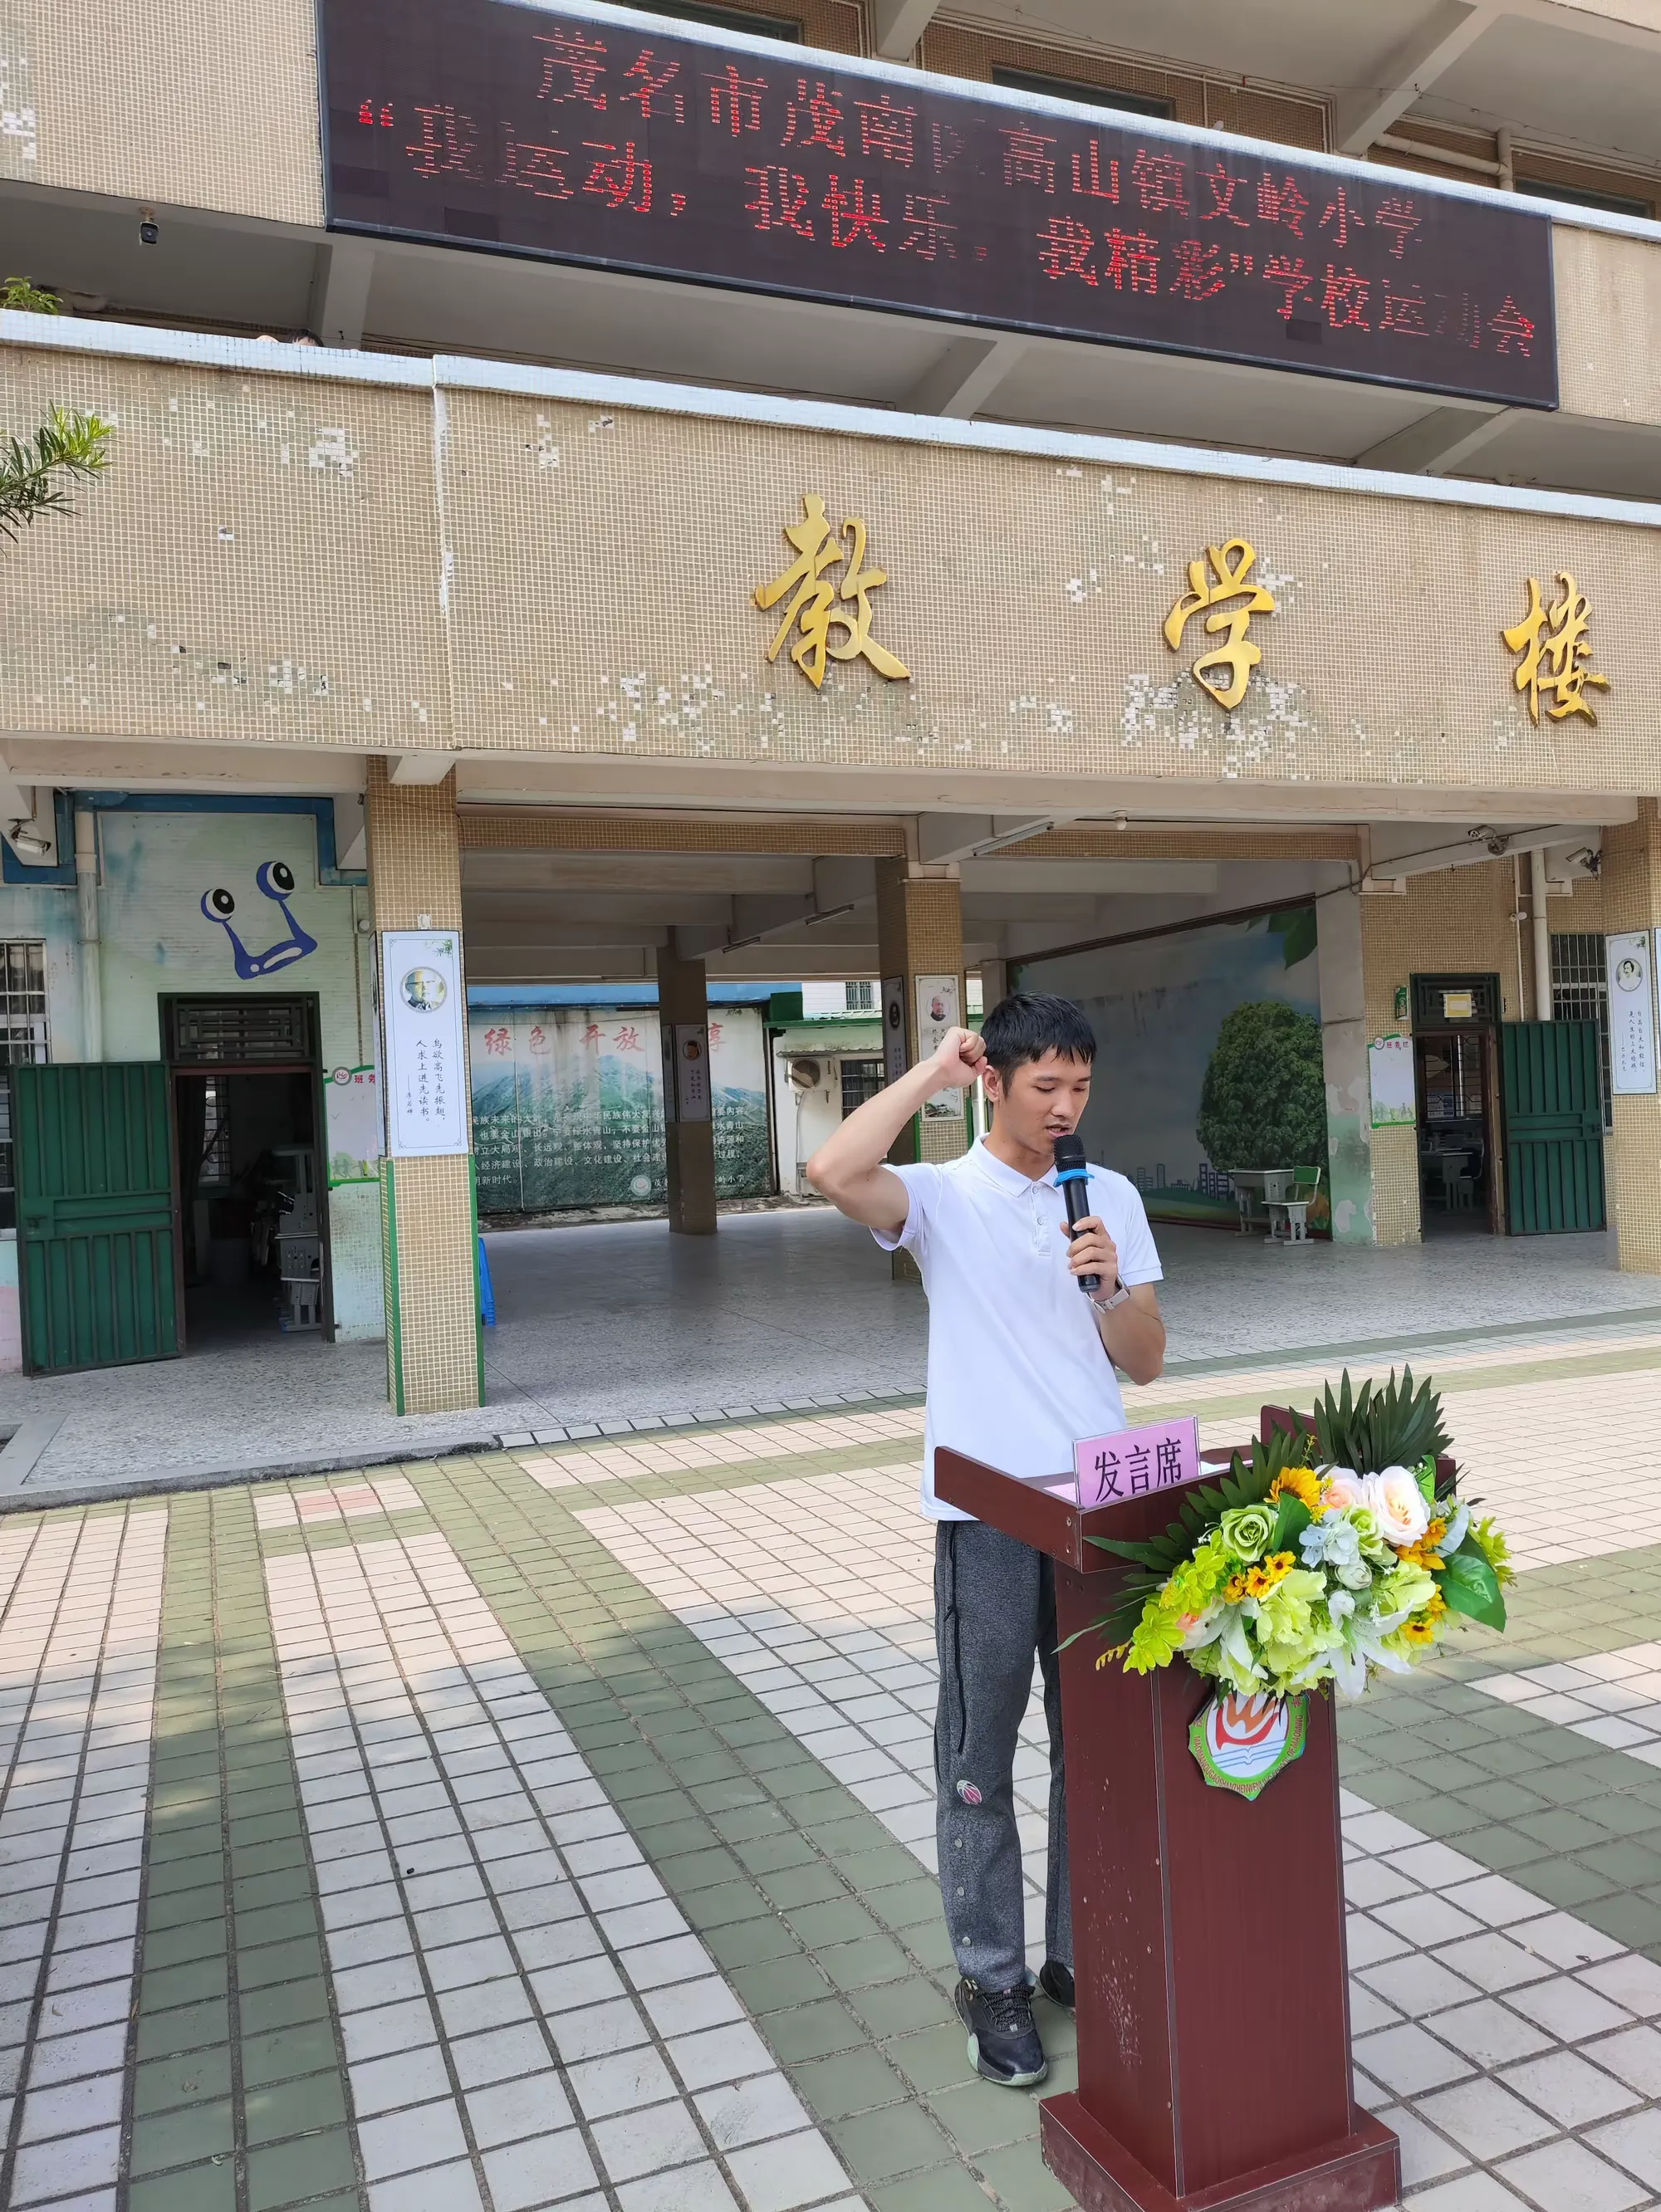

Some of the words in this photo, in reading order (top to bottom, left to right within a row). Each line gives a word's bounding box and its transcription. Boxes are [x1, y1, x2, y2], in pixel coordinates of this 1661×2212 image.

[754, 493, 1612, 727] 教学楼
[483, 1025, 551, 1056] 绿色
[579, 1023, 644, 1054] 开放
[415, 1040, 430, 1122] 人求上进先读书。
[713, 1120, 744, 1131] 水青山
[475, 1152, 667, 1171] 经济建设、政治建设、文化建设、社会建
[714, 1149, 740, 1160] 过程。
[1095, 1437, 1182, 1502] 发言席
